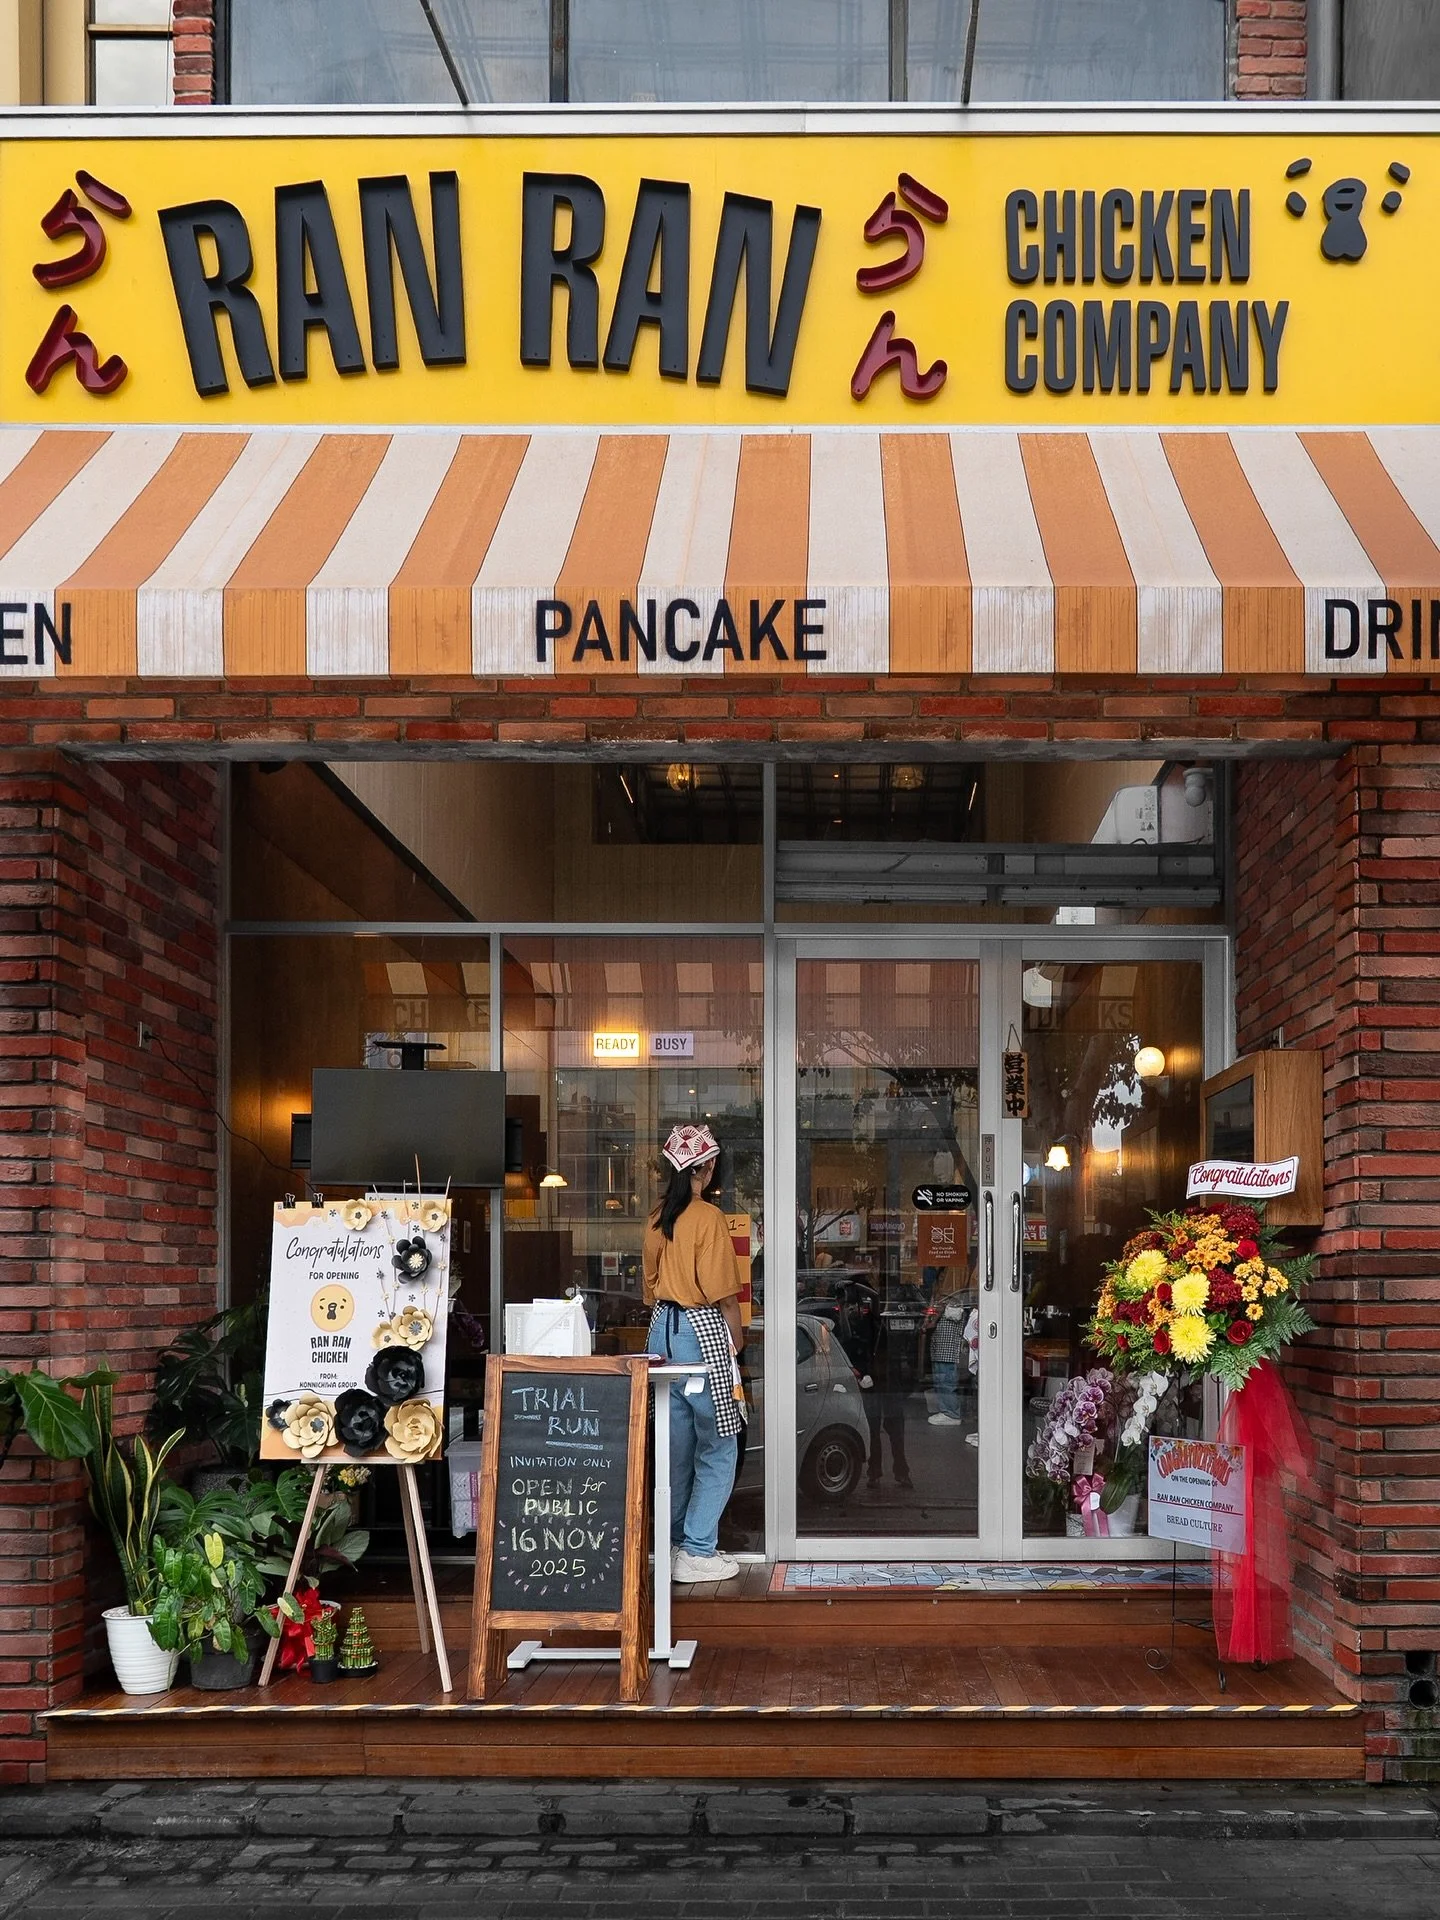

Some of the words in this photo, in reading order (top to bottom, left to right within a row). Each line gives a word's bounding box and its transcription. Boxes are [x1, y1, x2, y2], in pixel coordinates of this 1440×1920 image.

[1004, 188, 1251, 285] CHICKEN
[158, 170, 467, 397] RAN
[520, 171, 822, 397] RAN
[1004, 299, 1289, 394] COMPANY
[0, 602, 72, 665] EN
[536, 598, 827, 662] PANCAKE
[1325, 599, 1440, 660] DRI
[596, 1038, 636, 1050] READY
[655, 1038, 687, 1050] BUSY
[1003, 1053, 1025, 1117] 営業中
[1191, 1165, 1292, 1191] Congratulations
[286, 1235, 384, 1268] Congratulations
[309, 1271, 324, 1280] FOR
[326, 1271, 359, 1280] OPENING
[310, 1335, 329, 1349] RAN
[332, 1335, 352, 1349] RAN
[312, 1351, 348, 1363] CHICKEN
[512, 1386, 599, 1412] TRIAL
[547, 1415, 600, 1437] RUN
[510, 1455, 577, 1468] INVITATION
[583, 1457, 612, 1469] ONLY
[511, 1478, 573, 1496] OPEN
[580, 1477, 607, 1495] for
[1171, 1474, 1179, 1482] ON
[1179, 1475, 1188, 1483] THE
[1188, 1477, 1211, 1486] OPENING
[523, 1498, 598, 1517] PUBLIC
[1157, 1493, 1169, 1501] RAN
[1169, 1495, 1181, 1503] RAN
[1181, 1497, 1205, 1507] CHICKEN
[1205, 1500, 1234, 1511] COMPANY
[1166, 1514, 1189, 1526] BREAD
[1189, 1518, 1223, 1533] CULTURE
[511, 1526, 537, 1552] 16
[543, 1526, 604, 1551] NOV
[528, 1558, 586, 1577] 2025
